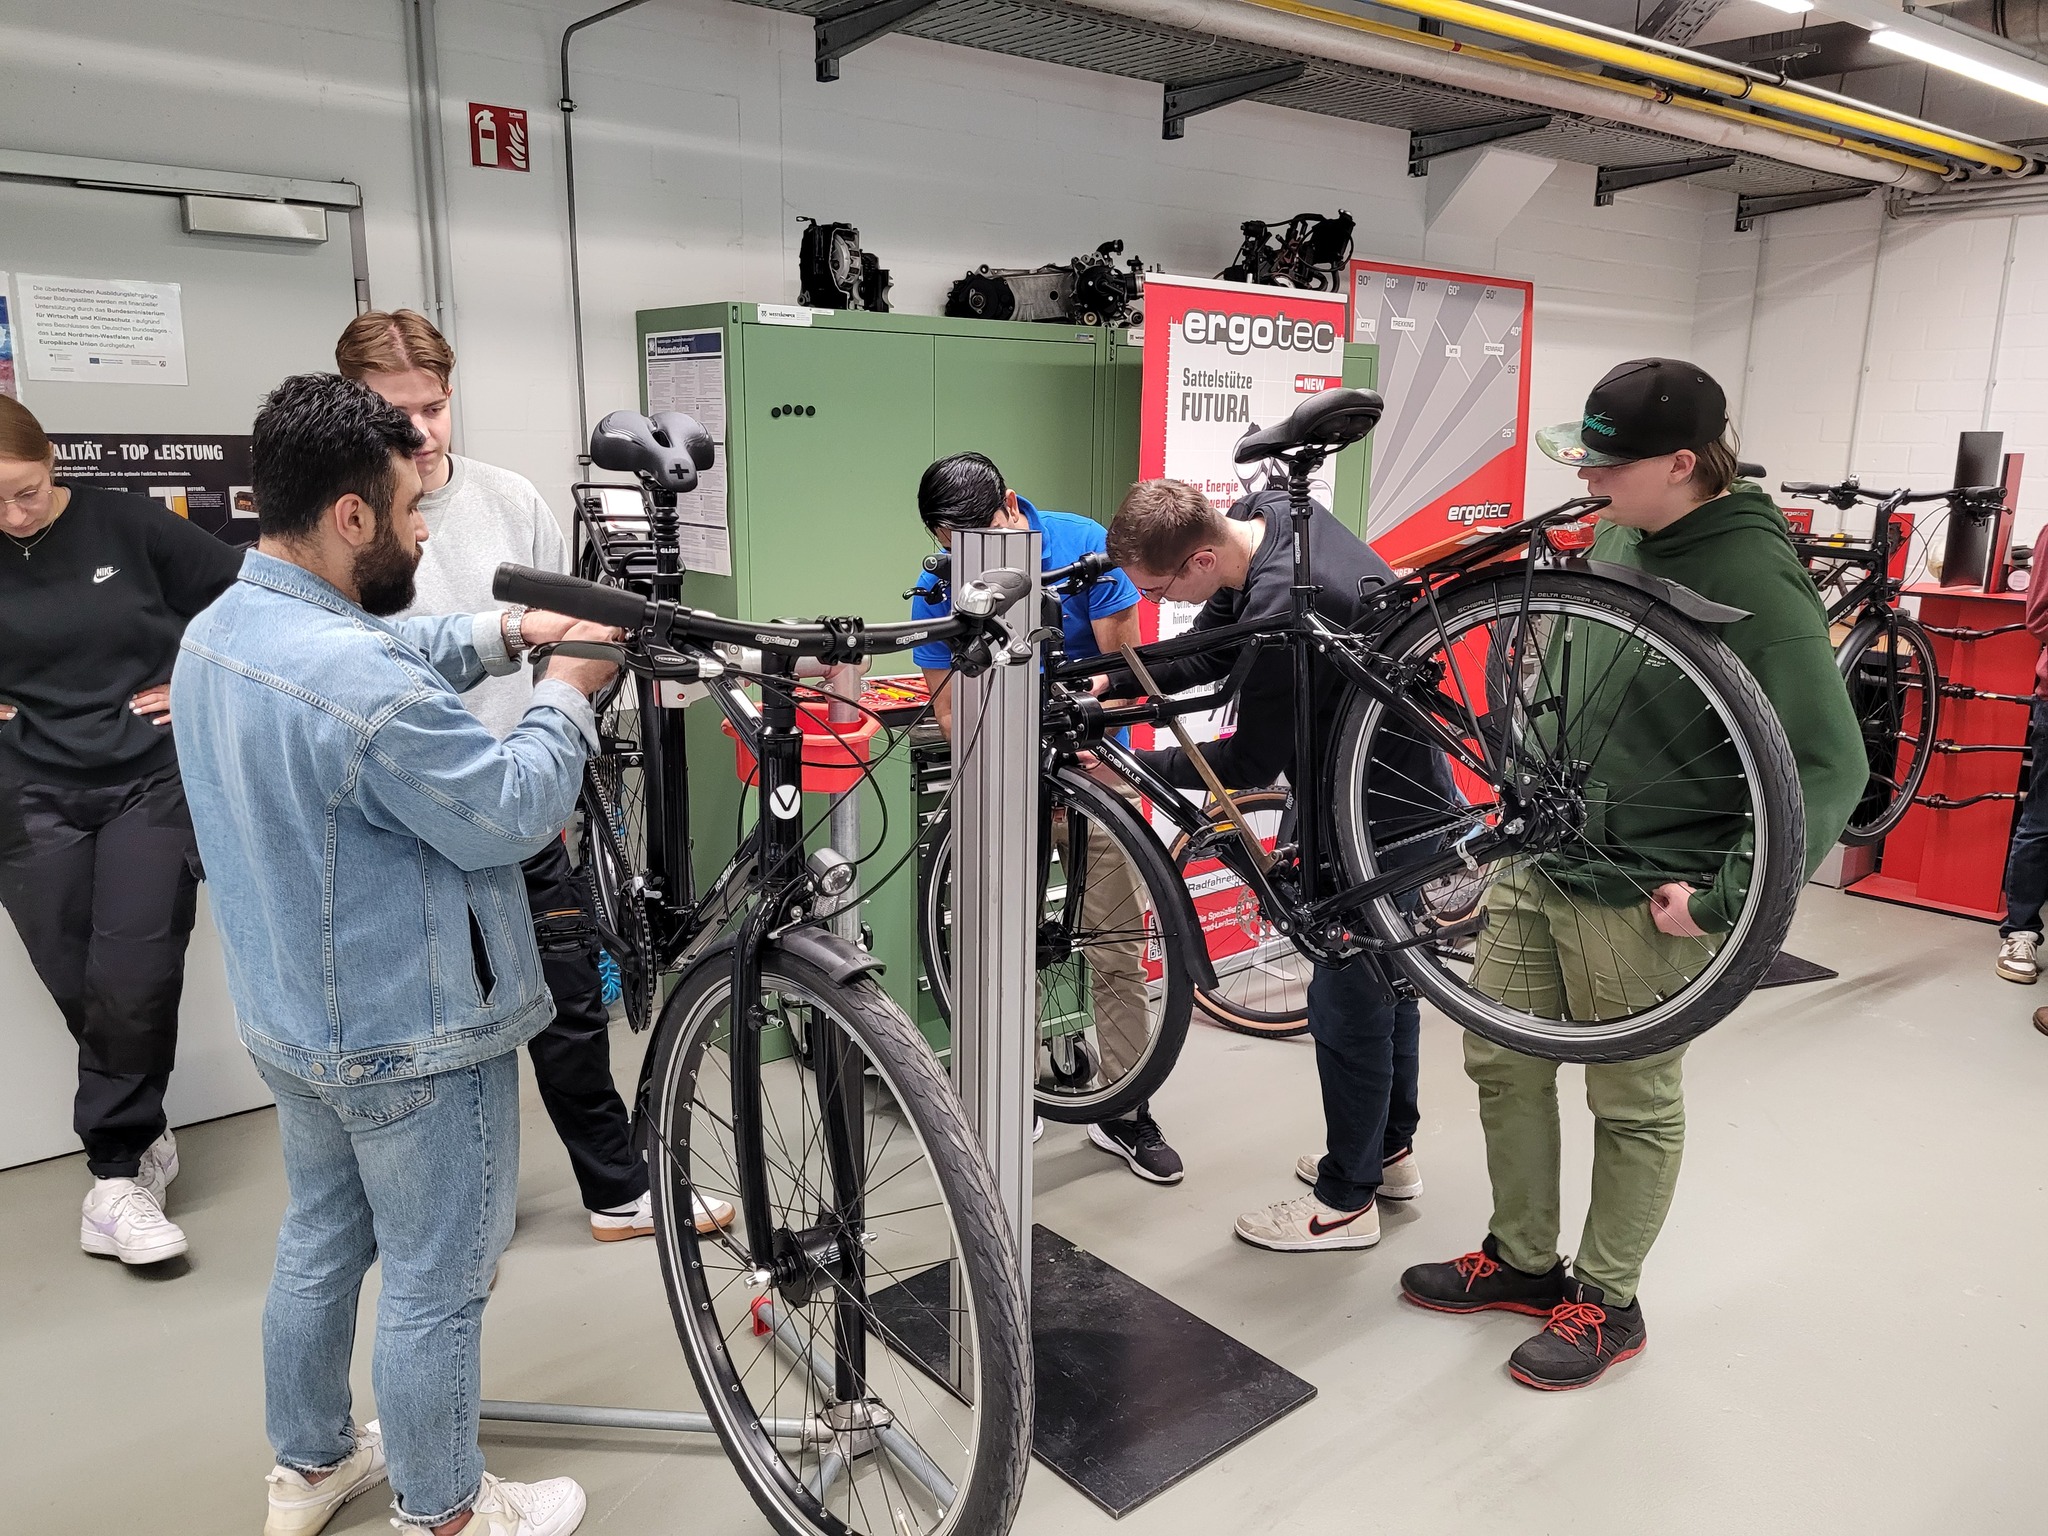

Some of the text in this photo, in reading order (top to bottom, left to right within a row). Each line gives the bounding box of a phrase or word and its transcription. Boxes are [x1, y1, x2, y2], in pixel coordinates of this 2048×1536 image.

[1358, 275, 1371, 286] 90°
[1386, 277, 1399, 289] 80°
[1416, 281, 1428, 292] 70°
[1447, 285, 1460, 296] 60°
[1485, 289, 1497, 299] 50°
[107, 308, 165, 316] Bundesministerium
[1360, 321, 1371, 329] CITY
[1393, 320, 1414, 329] TREKKING
[68, 332, 130, 340] Nordrhein-Westfalen
[1184, 310, 1334, 354] ergotec
[1183, 367, 1253, 389] Sattelstütze
[1303, 378, 1326, 391] NEW
[1181, 392, 1250, 422] FUTURA
[1502, 428, 1515, 438] 25°
[54, 441, 103, 460] ALITÄT
[120, 444, 149, 460] TOP
[154, 444, 224, 460] LEISTUNG
[1206, 479, 1239, 495] Energie
[1447, 500, 1512, 526] ergotec
[96, 566, 114, 577] NIKE
[1457, 598, 1495, 613] SCHWALB
[1561, 593, 1591, 603] CRUISER
[1592, 599, 1612, 609] PLUS
[1173, 612, 1192, 625] hinten
[755, 634, 790, 648] ergotec
[895, 631, 928, 645] ergotec
